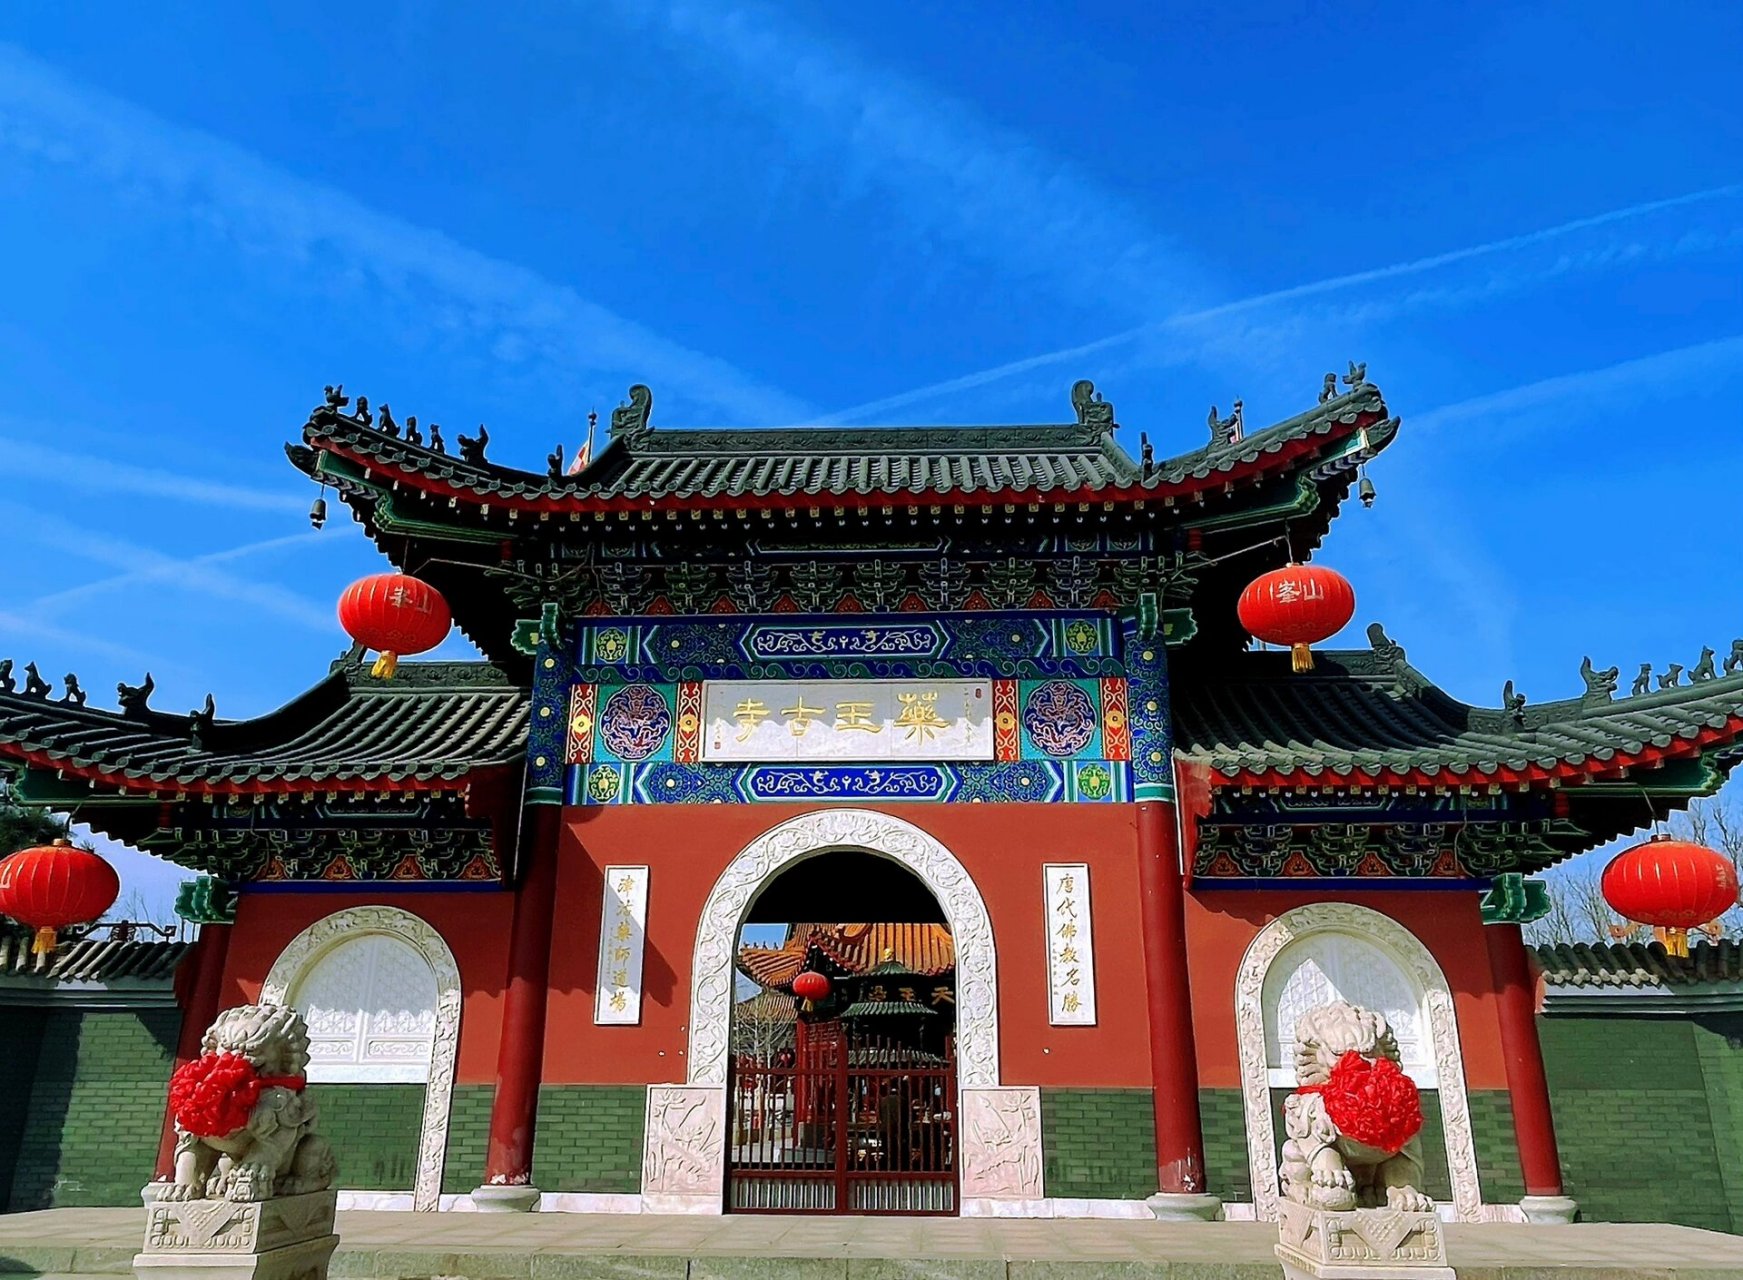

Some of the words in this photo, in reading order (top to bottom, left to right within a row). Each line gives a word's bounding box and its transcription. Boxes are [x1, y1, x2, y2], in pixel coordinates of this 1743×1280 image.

[1055, 873, 1082, 1012] 唐代佛教名勝
